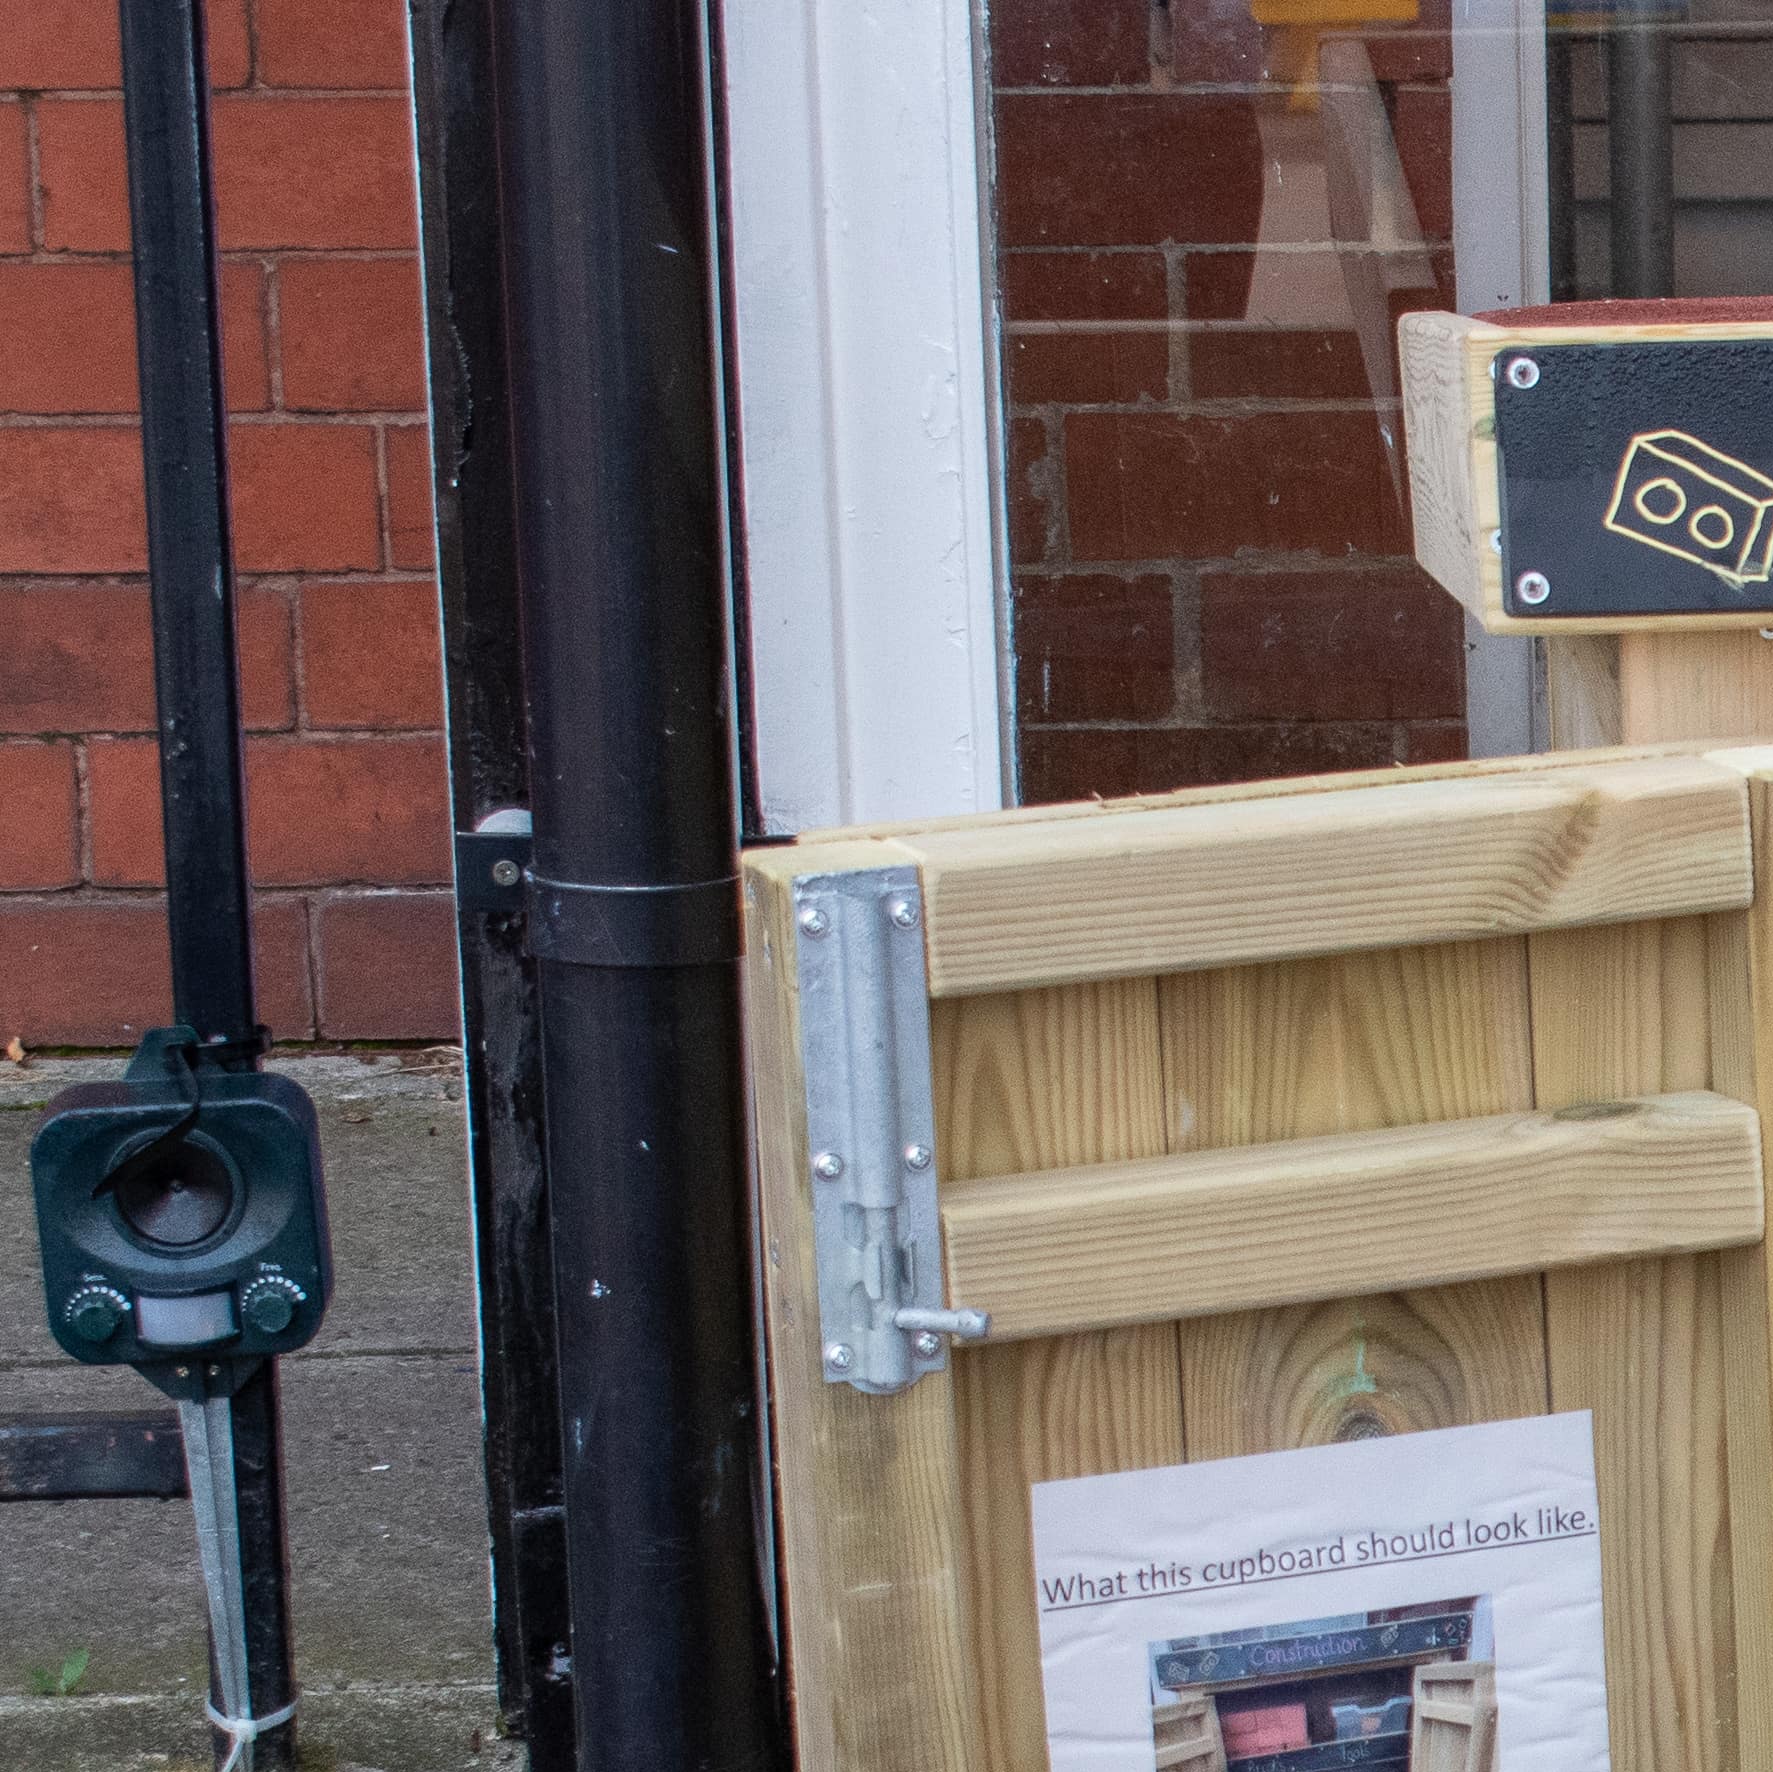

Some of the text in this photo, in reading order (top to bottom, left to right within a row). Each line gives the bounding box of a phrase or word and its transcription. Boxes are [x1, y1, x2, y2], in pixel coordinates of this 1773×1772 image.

[1042, 1506, 1595, 1604] What this cupboard should look like.
